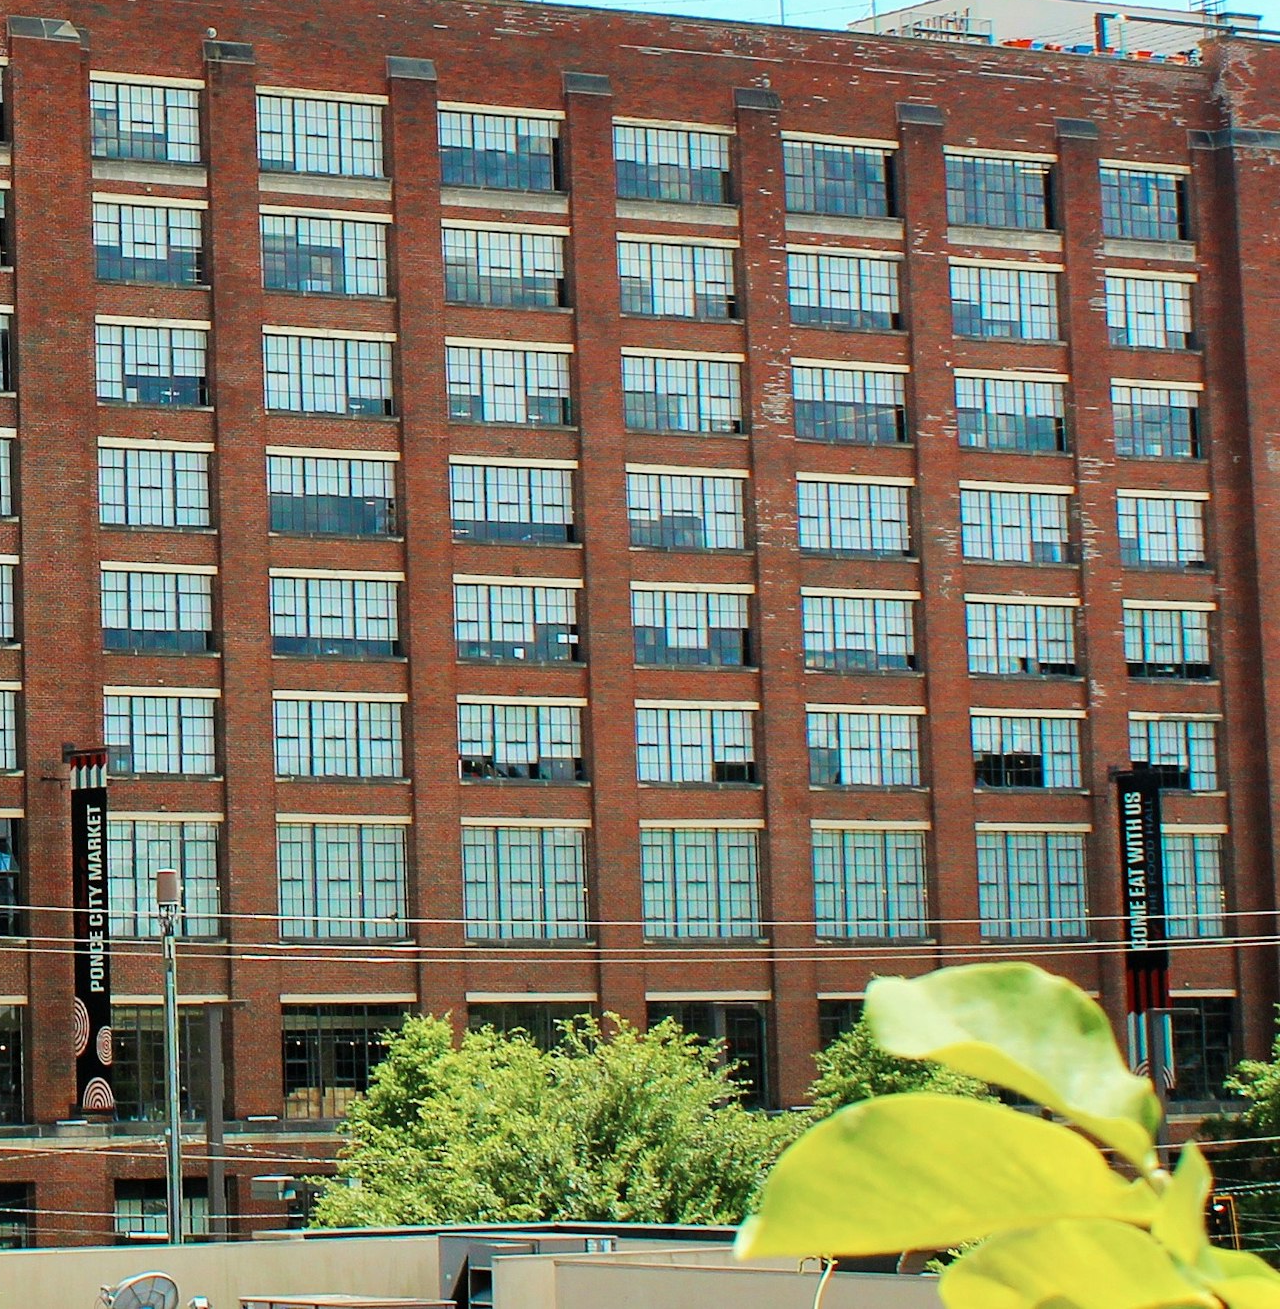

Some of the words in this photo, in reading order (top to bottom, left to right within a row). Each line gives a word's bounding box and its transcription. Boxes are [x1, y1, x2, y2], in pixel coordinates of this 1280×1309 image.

[1124, 791, 1142, 816] US
[1144, 797, 1154, 835] HALL
[86, 804, 102, 880] MARKET
[1125, 818, 1145, 864] WITH
[1146, 841, 1157, 885] FOOD
[1127, 867, 1147, 898] EAT
[88, 884, 104, 927] CITY
[1129, 900, 1149, 950] COME
[90, 930, 105, 993] PONCE
